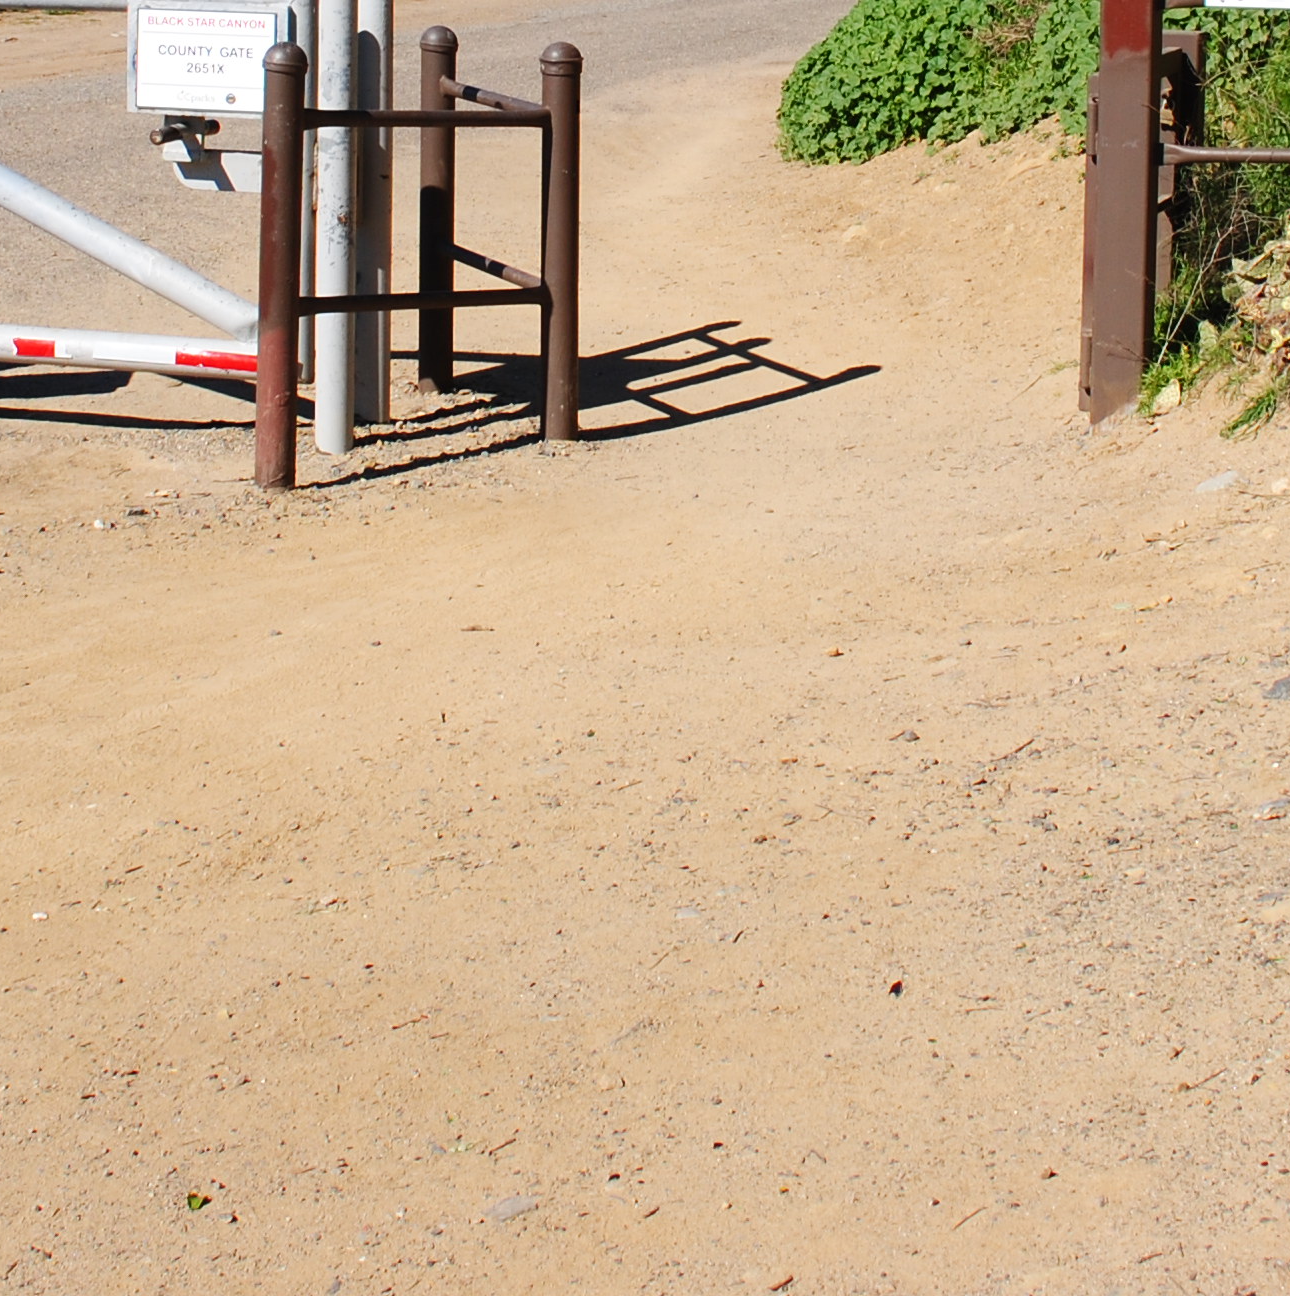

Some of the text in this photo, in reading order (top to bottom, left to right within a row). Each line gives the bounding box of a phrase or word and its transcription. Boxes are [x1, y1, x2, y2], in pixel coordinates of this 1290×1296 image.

[148, 16, 265, 29] BLACK STAR CANYON
[158, 44, 253, 58] COUNTY GATE
[187, 63, 225, 74] 2651X
